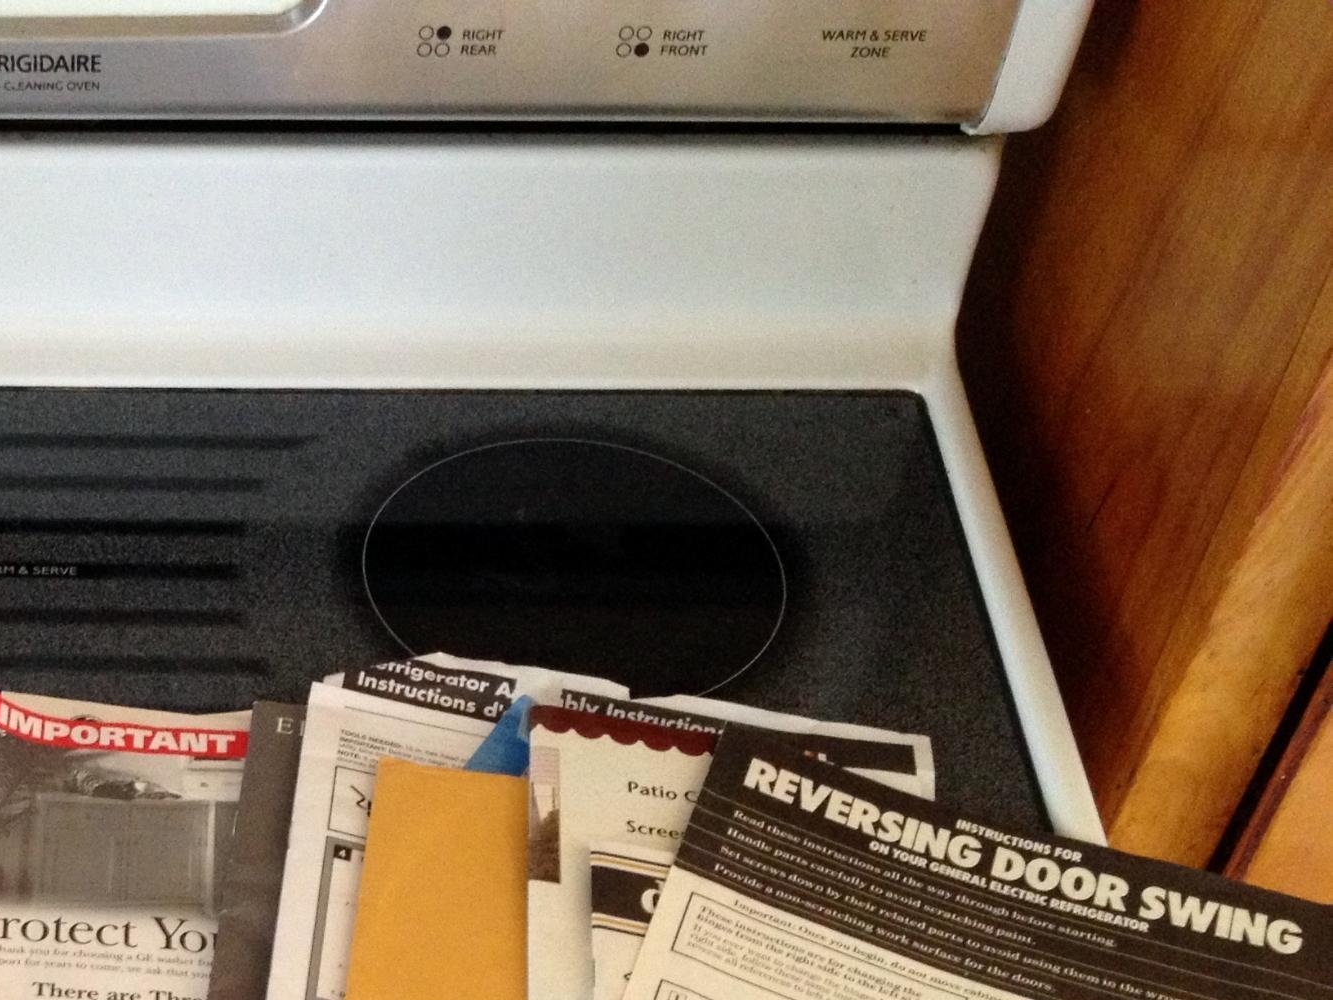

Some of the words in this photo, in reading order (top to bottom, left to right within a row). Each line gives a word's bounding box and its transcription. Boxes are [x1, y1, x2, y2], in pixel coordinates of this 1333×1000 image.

[462, 30, 504, 40] RIGHT
[663, 30, 705, 41] RIGHT
[822, 30, 866, 40] WARM
[870, 30, 879, 41] &
[884, 30, 927, 41] SERVE
[460, 44, 496, 56] REAR
[660, 45, 708, 56] FRONT
[851, 46, 890, 58] ZONE
[67, 81, 100, 91] OVEN
[19, 565, 28, 575] &
[33, 566, 77, 576] SERVE
[358, 672, 476, 713] Instructions
[606, 703, 724, 735] Instruction
[628, 781, 677, 800] Patio
[956, 818, 1052, 855] INSTRUCTIONS
[1054, 846, 1083, 863] FOR
[742, 757, 983, 869] REVERSING
[990, 845, 1130, 913] DOOR
[1138, 885, 1304, 955] SWING
[733, 809, 765, 829] Read
[767, 824, 801, 843] these
[803, 838, 881, 873] instructions
[883, 870, 901, 881] all
[903, 875, 924, 888] the
[927, 883, 952, 899] way
[956, 893, 1010, 917] through
[1012, 910, 1055, 929] before
[726, 827, 773, 852] Handle
[774, 848, 808, 866] parts
[810, 862, 867, 889] carefully
[869, 884, 883, 895] to
[885, 889, 922, 908] avoid
[923, 902, 994, 934] scratching
[869, 841, 889, 855] ON
[892, 848, 928, 868] YOUR
[929, 861, 988, 888] GENERAL
[989, 880, 1048, 907] ELECTRIC
[1049, 897, 1150, 933] REFRIGERATOR
[714, 862, 764, 889] Provide
[775, 889, 874, 932] non-scratching
[877, 924, 909, 945] work
[911, 939, 962, 962] surface
[965, 958, 985, 970] for
[987, 965, 1010, 978] the
[153, 916, 216, 953] Yo
[32, 981, 99, 1000] There
